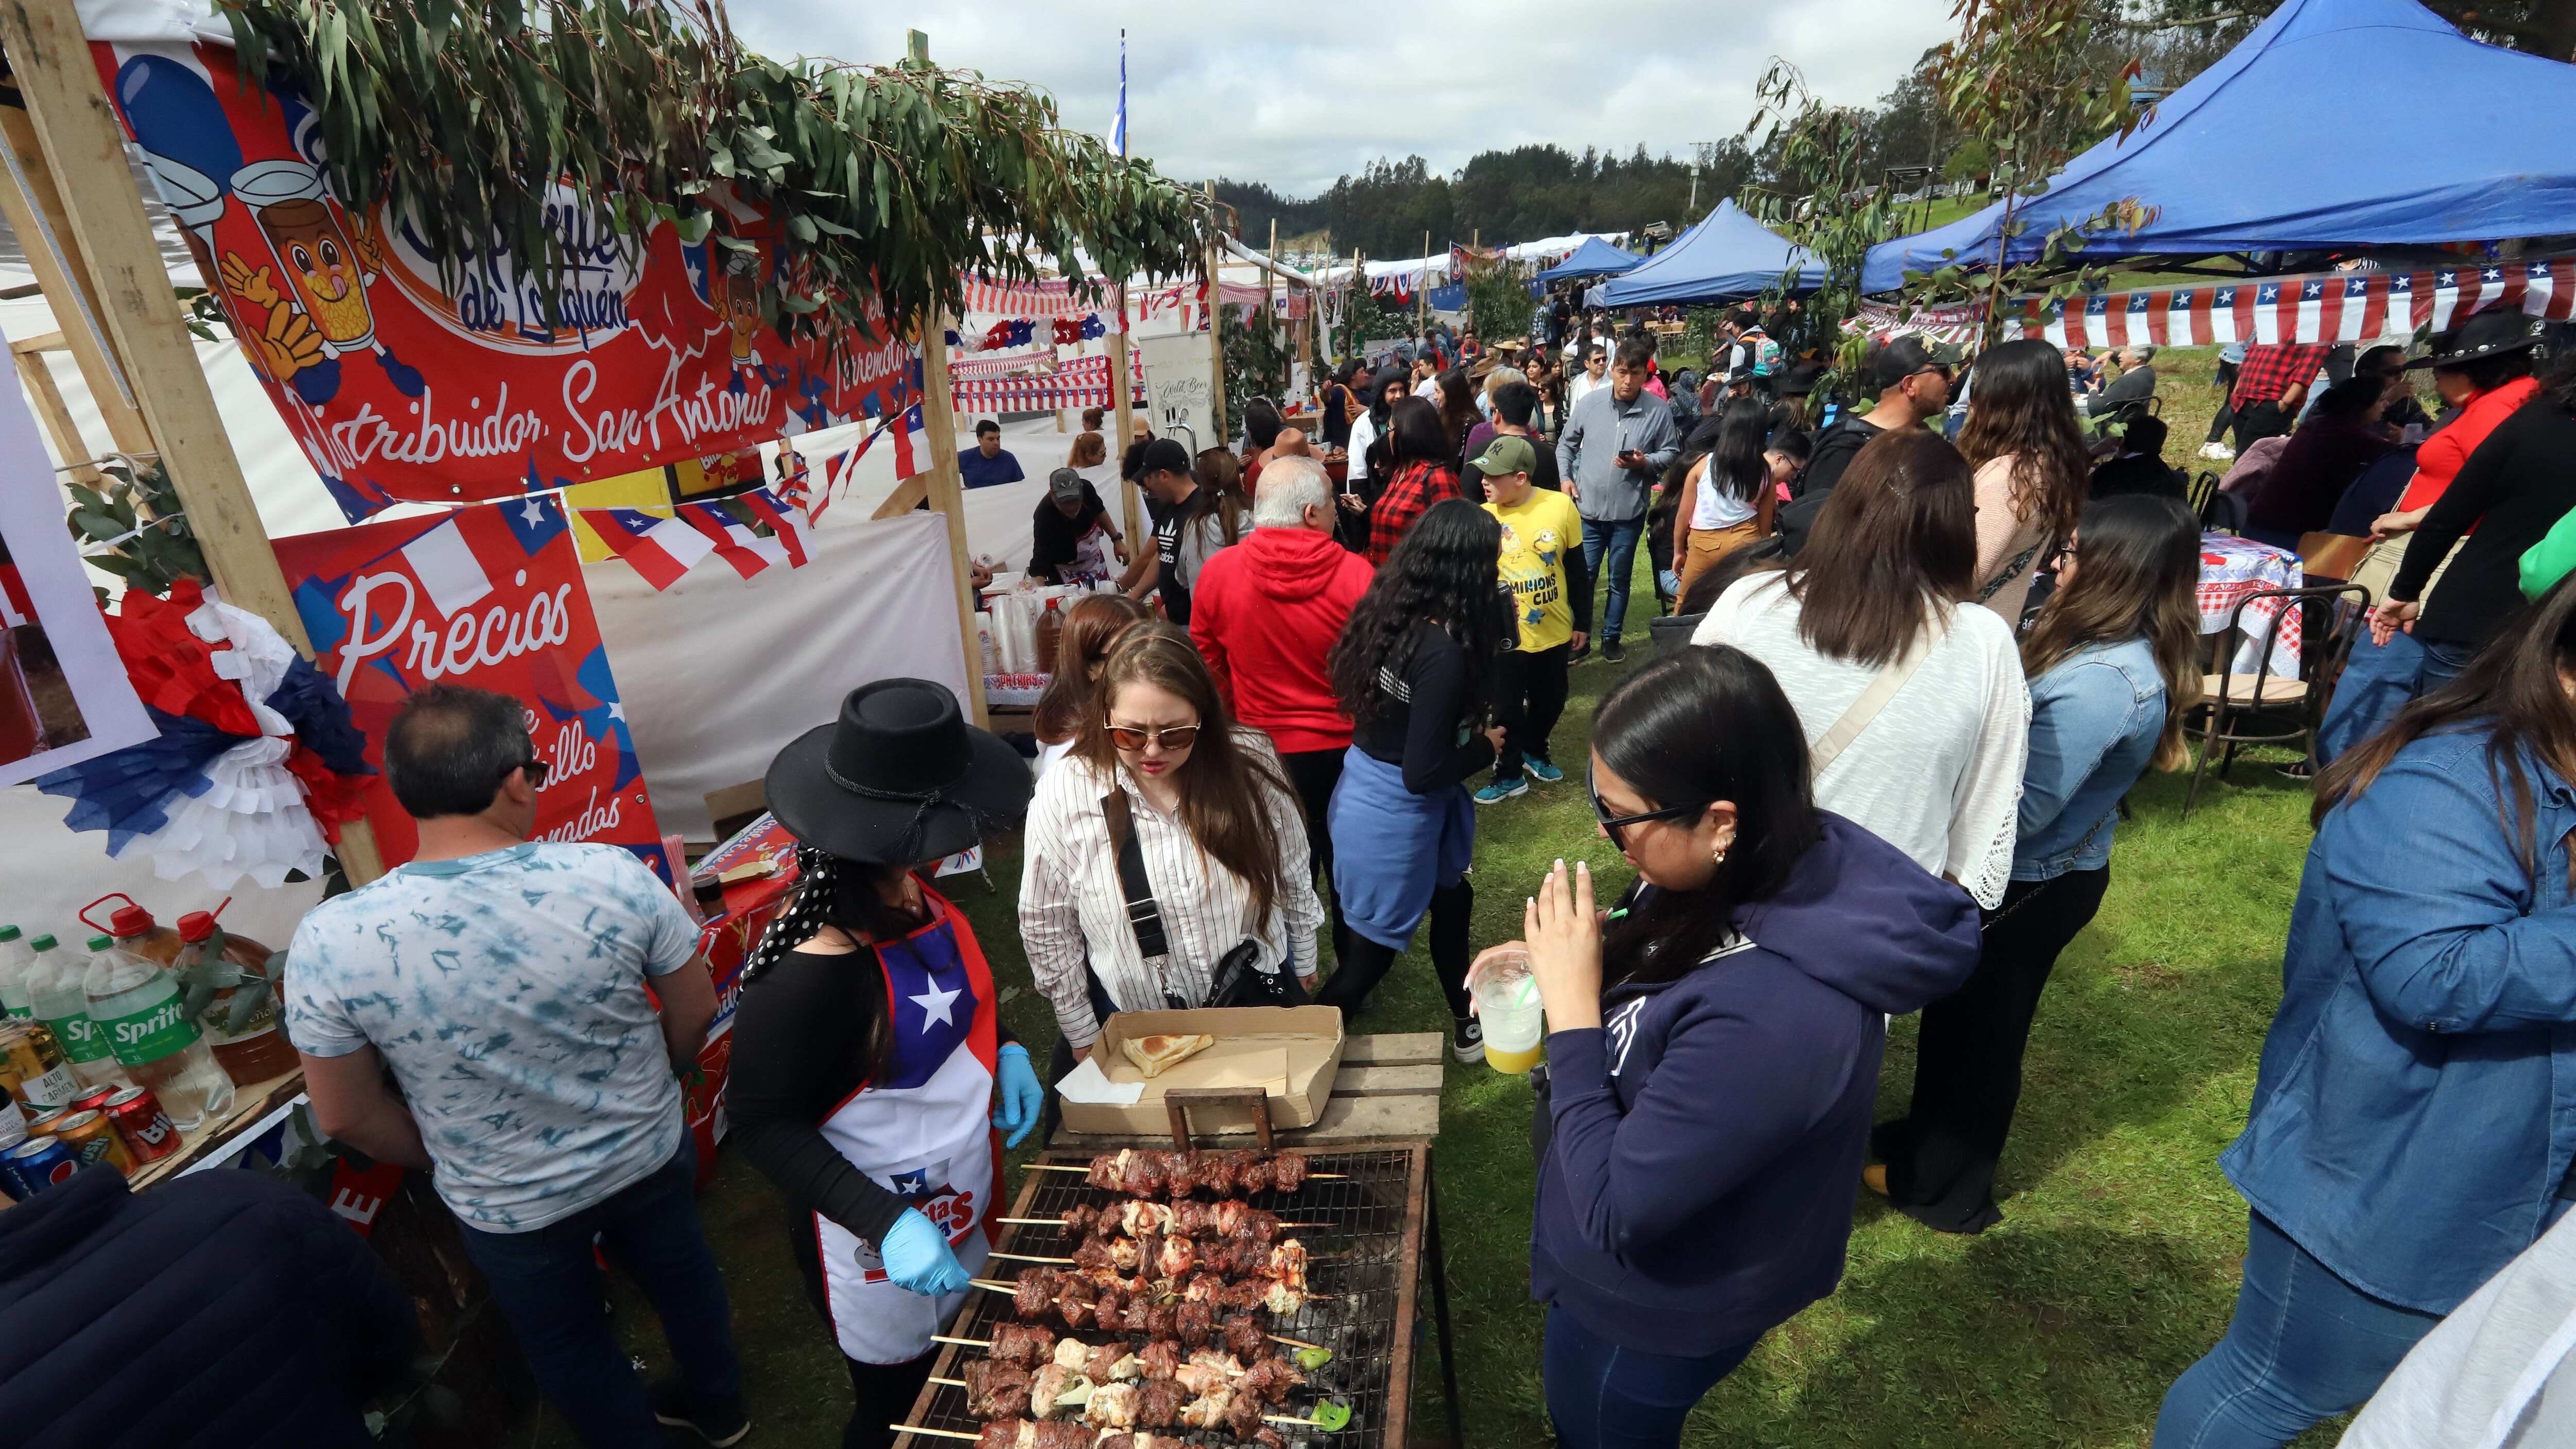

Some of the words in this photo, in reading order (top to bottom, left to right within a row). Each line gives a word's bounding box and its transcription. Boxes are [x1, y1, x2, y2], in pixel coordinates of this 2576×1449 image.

[462, 273, 505, 331] de
[1156, 380, 1185, 399] Wild
[1185, 377, 1208, 393] Beer
[280, 379, 549, 481] Distribuidor
[563, 360, 642, 463] San
[644, 353, 771, 451] Antonio
[1510, 573, 1556, 594] MINIONS
[1533, 586, 1558, 605] CLUB
[336, 568, 571, 700] Precios
[43, 1071, 62, 1088] ALTO
[41, 1080, 75, 1104] CARMEN
